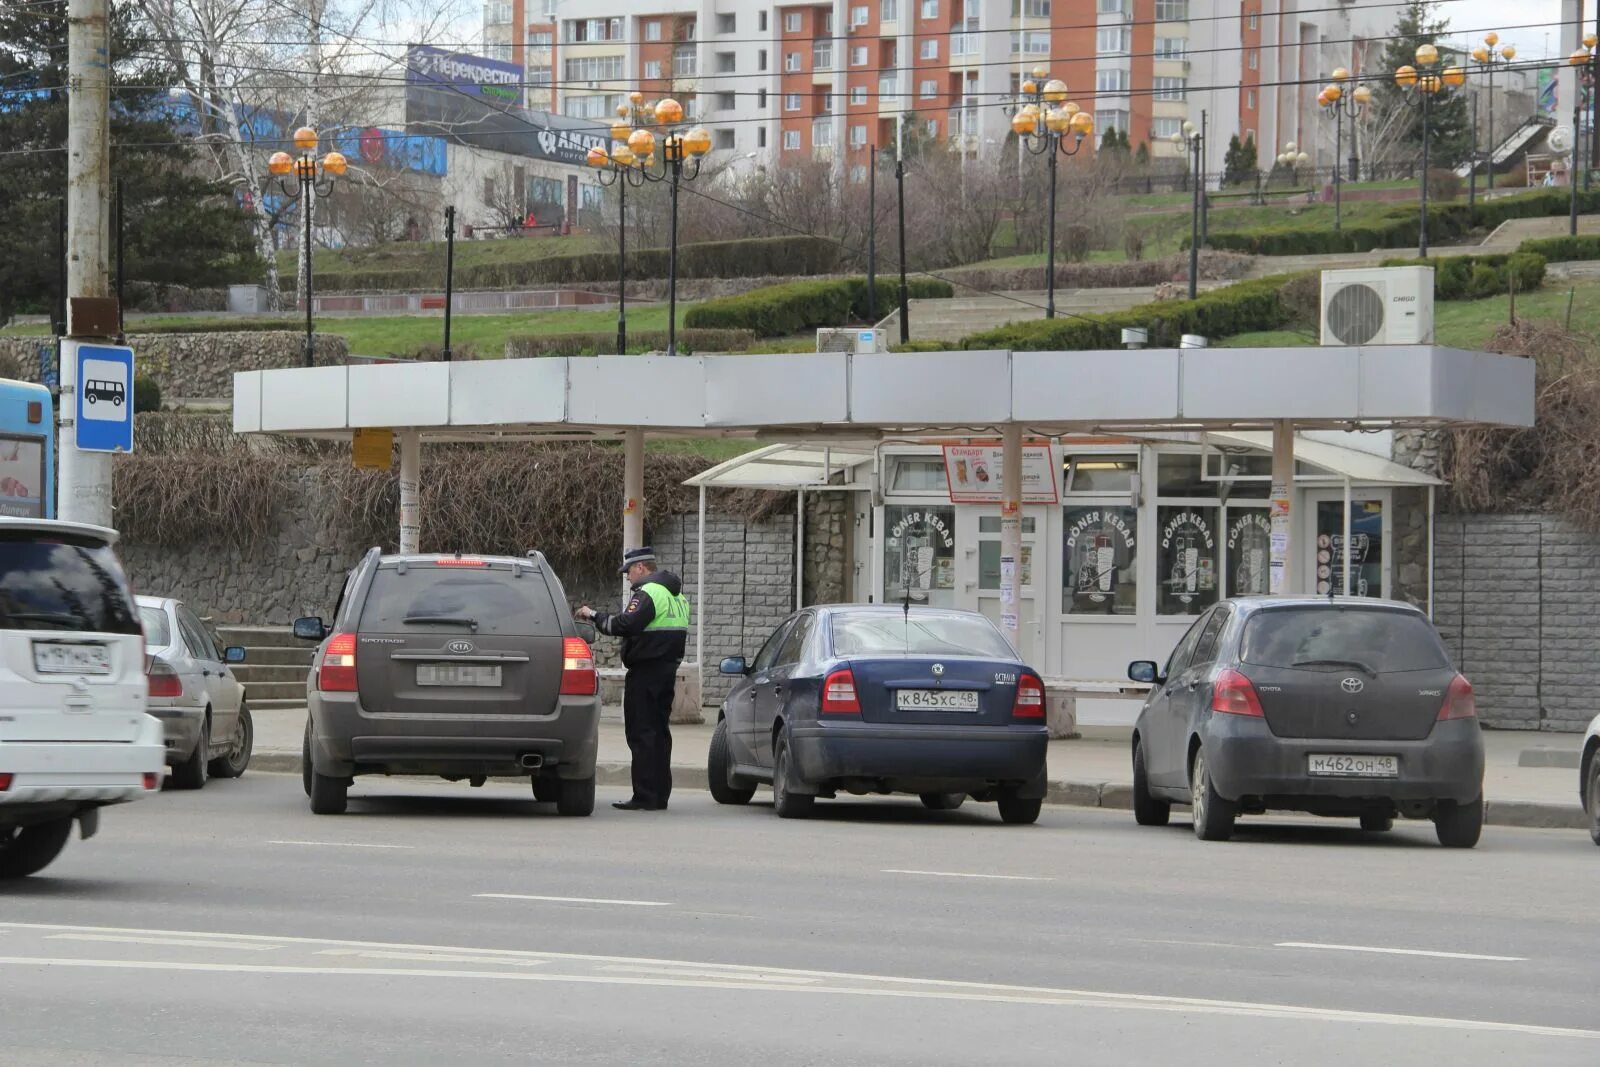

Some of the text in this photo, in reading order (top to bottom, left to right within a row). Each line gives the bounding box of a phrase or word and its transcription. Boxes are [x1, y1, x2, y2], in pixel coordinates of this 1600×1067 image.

[889, 512, 953, 548] DÖNER KEBAB
[1067, 511, 1135, 548] DÖNER KEBAB
[1162, 513, 1214, 549] DÖNER KEBAB
[1228, 514, 1252, 549] DÖNER
[1255, 514, 1271, 536] KEB
